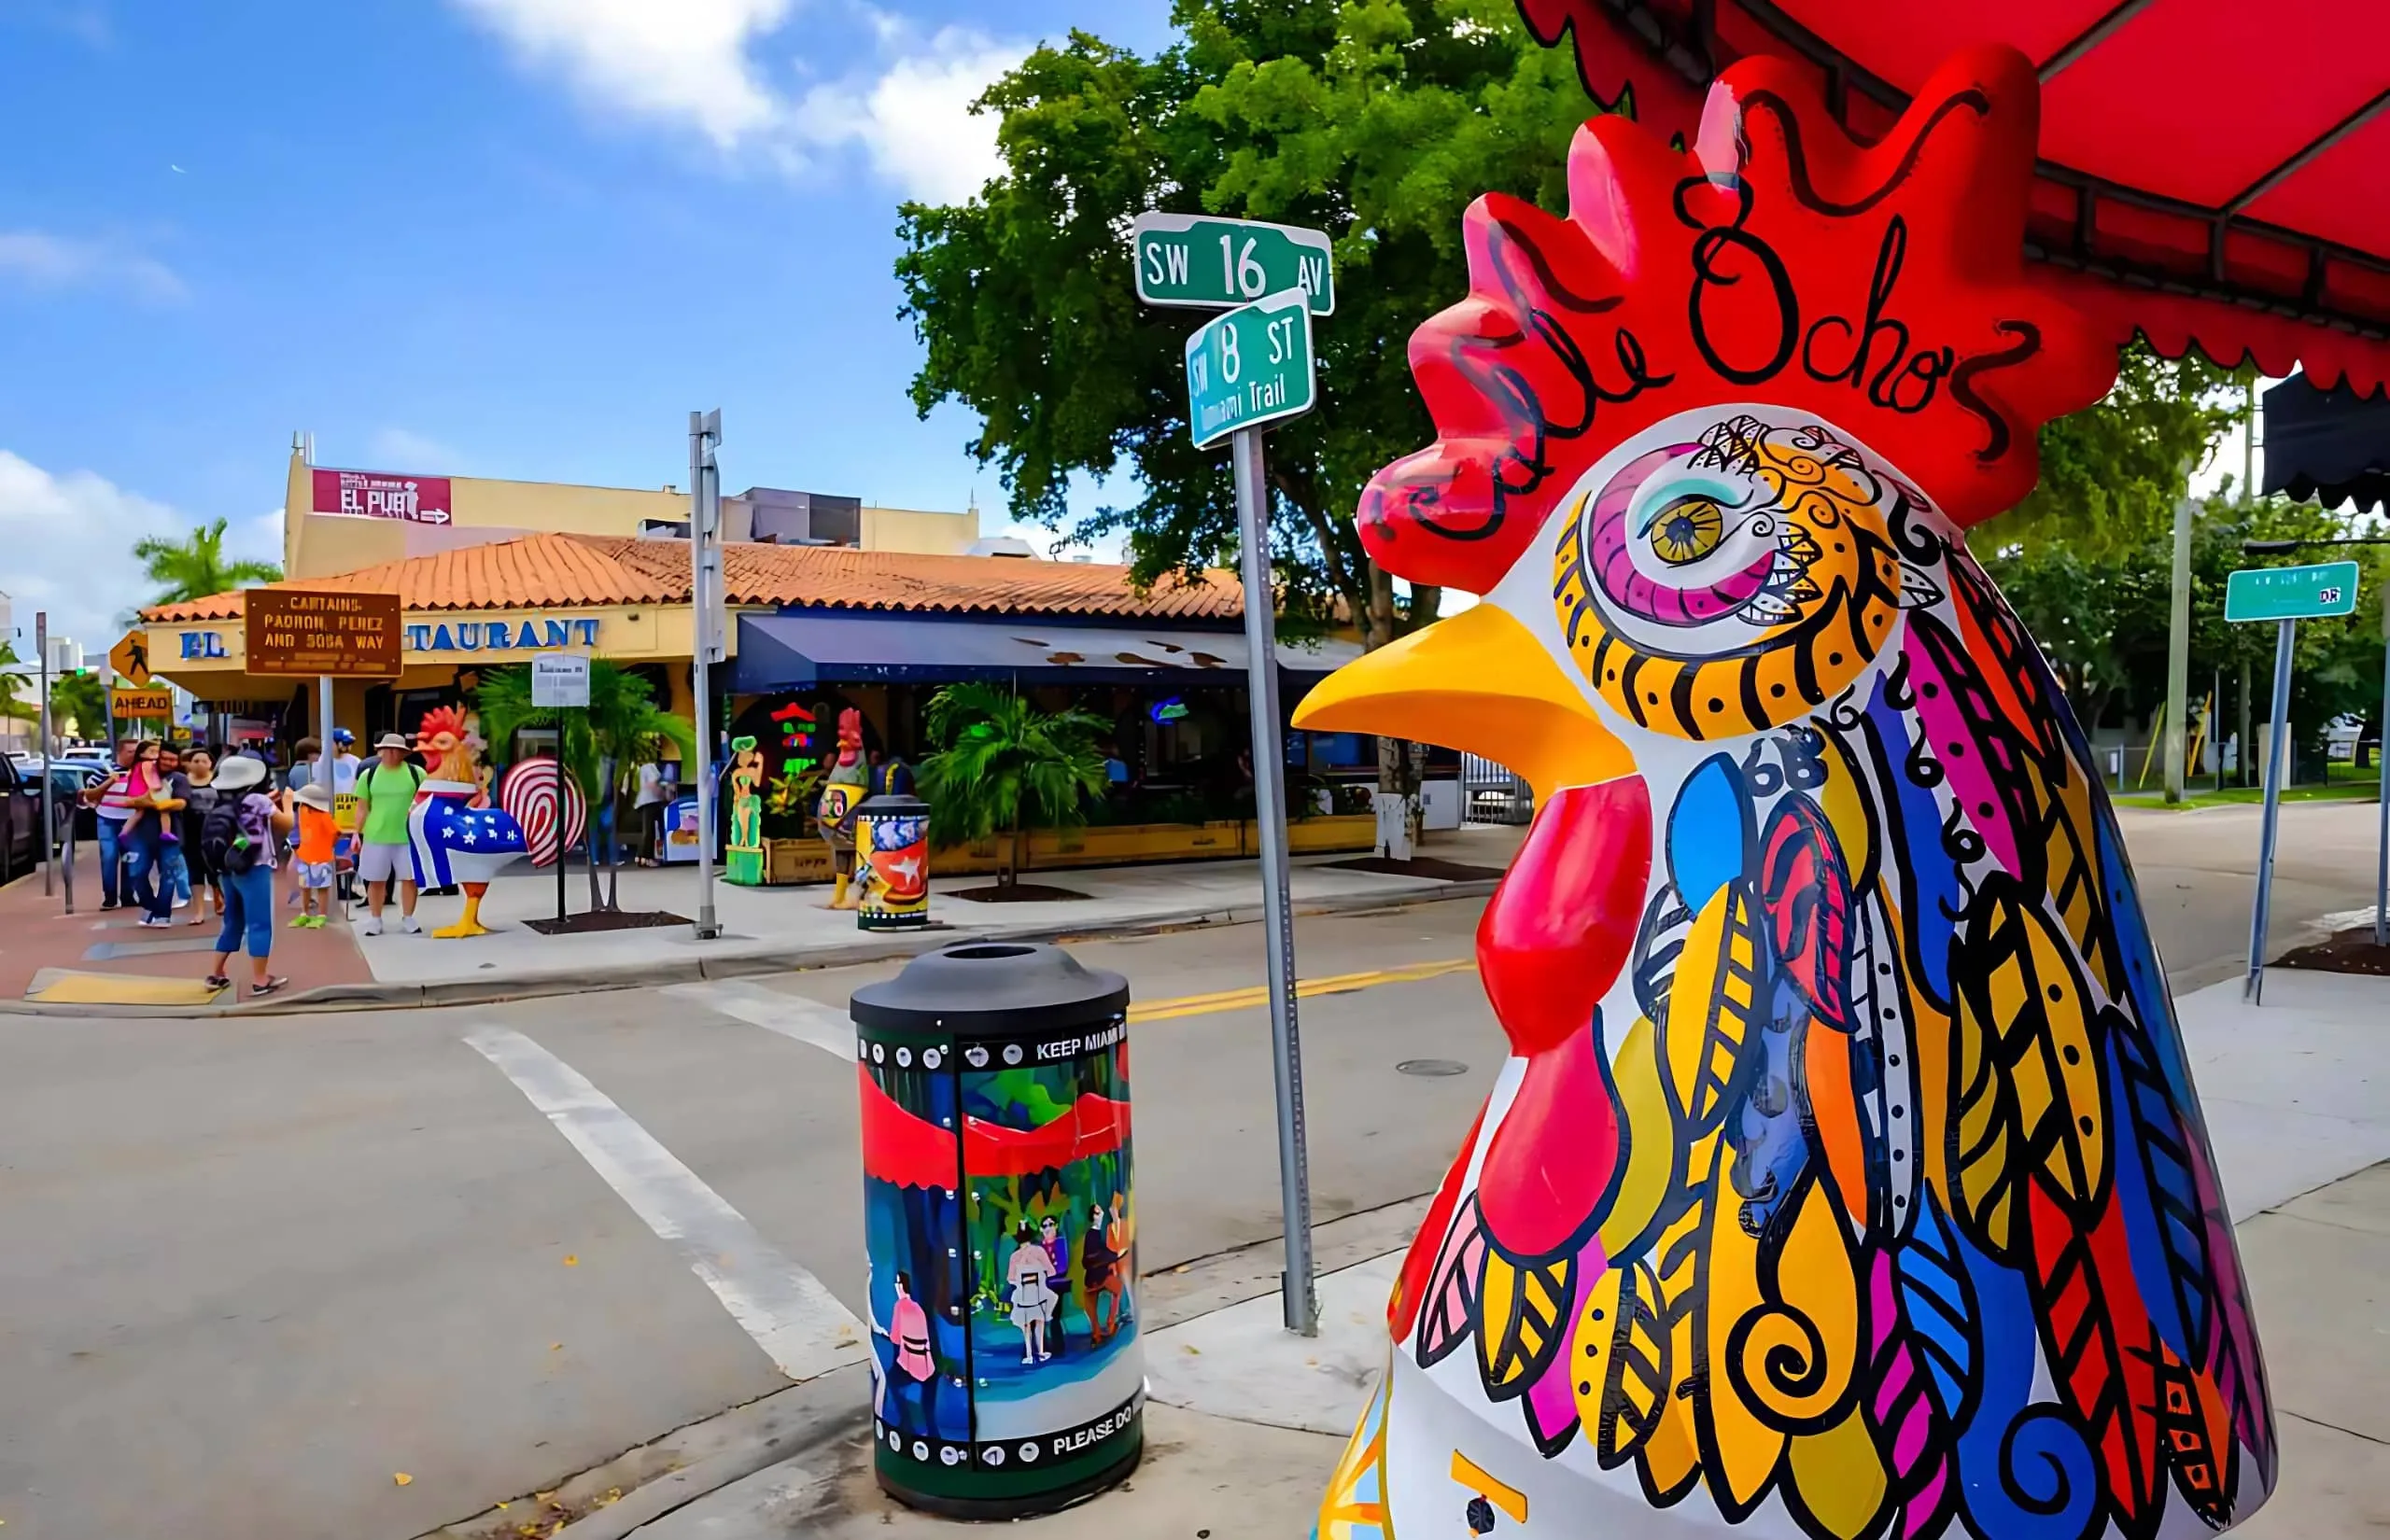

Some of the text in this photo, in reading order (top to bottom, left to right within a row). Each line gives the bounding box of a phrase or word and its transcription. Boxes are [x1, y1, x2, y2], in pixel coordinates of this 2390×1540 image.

[1146, 234, 1323, 299] SW 16 AV
[1191, 316, 1294, 398] SW 8 ST
[1248, 373, 1286, 412] Trail
[264, 634, 295, 648] AND
[356, 636, 384, 650] WAY
[404, 619, 600, 651] TAURANT
[115, 696, 167, 710] AHEAD
[1037, 1038, 1081, 1060] KEEP
[1053, 1406, 1132, 1455] PLEASE DO
